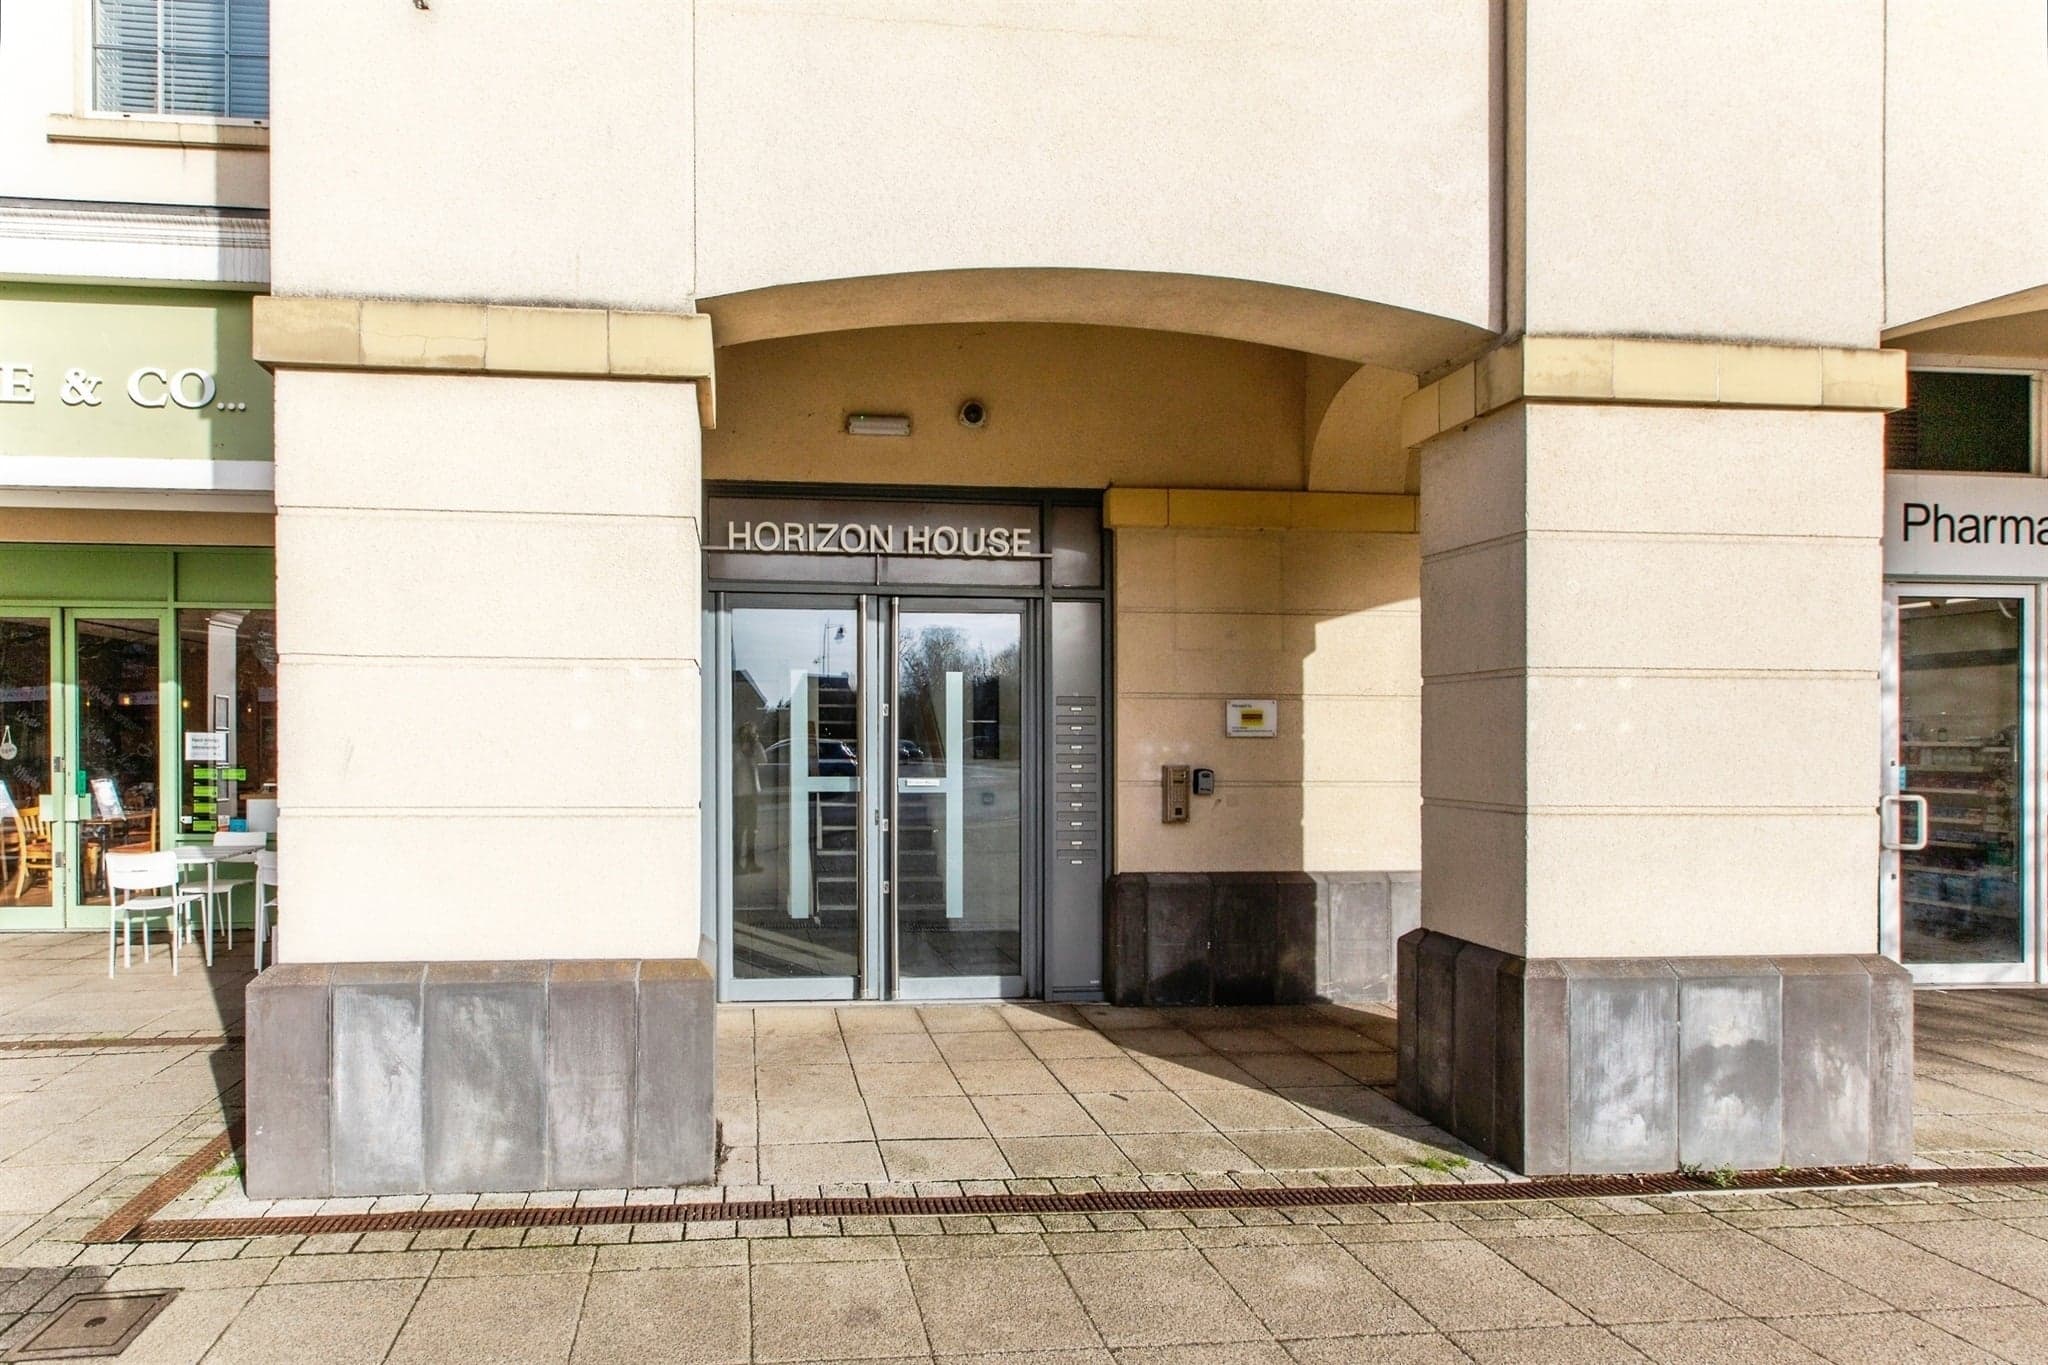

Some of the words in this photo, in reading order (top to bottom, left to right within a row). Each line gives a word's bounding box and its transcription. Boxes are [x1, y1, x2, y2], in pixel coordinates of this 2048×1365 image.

[60, 367, 103, 407] &
[728, 520, 893, 554] HORIZON
[907, 525, 1031, 557] HOUSE
